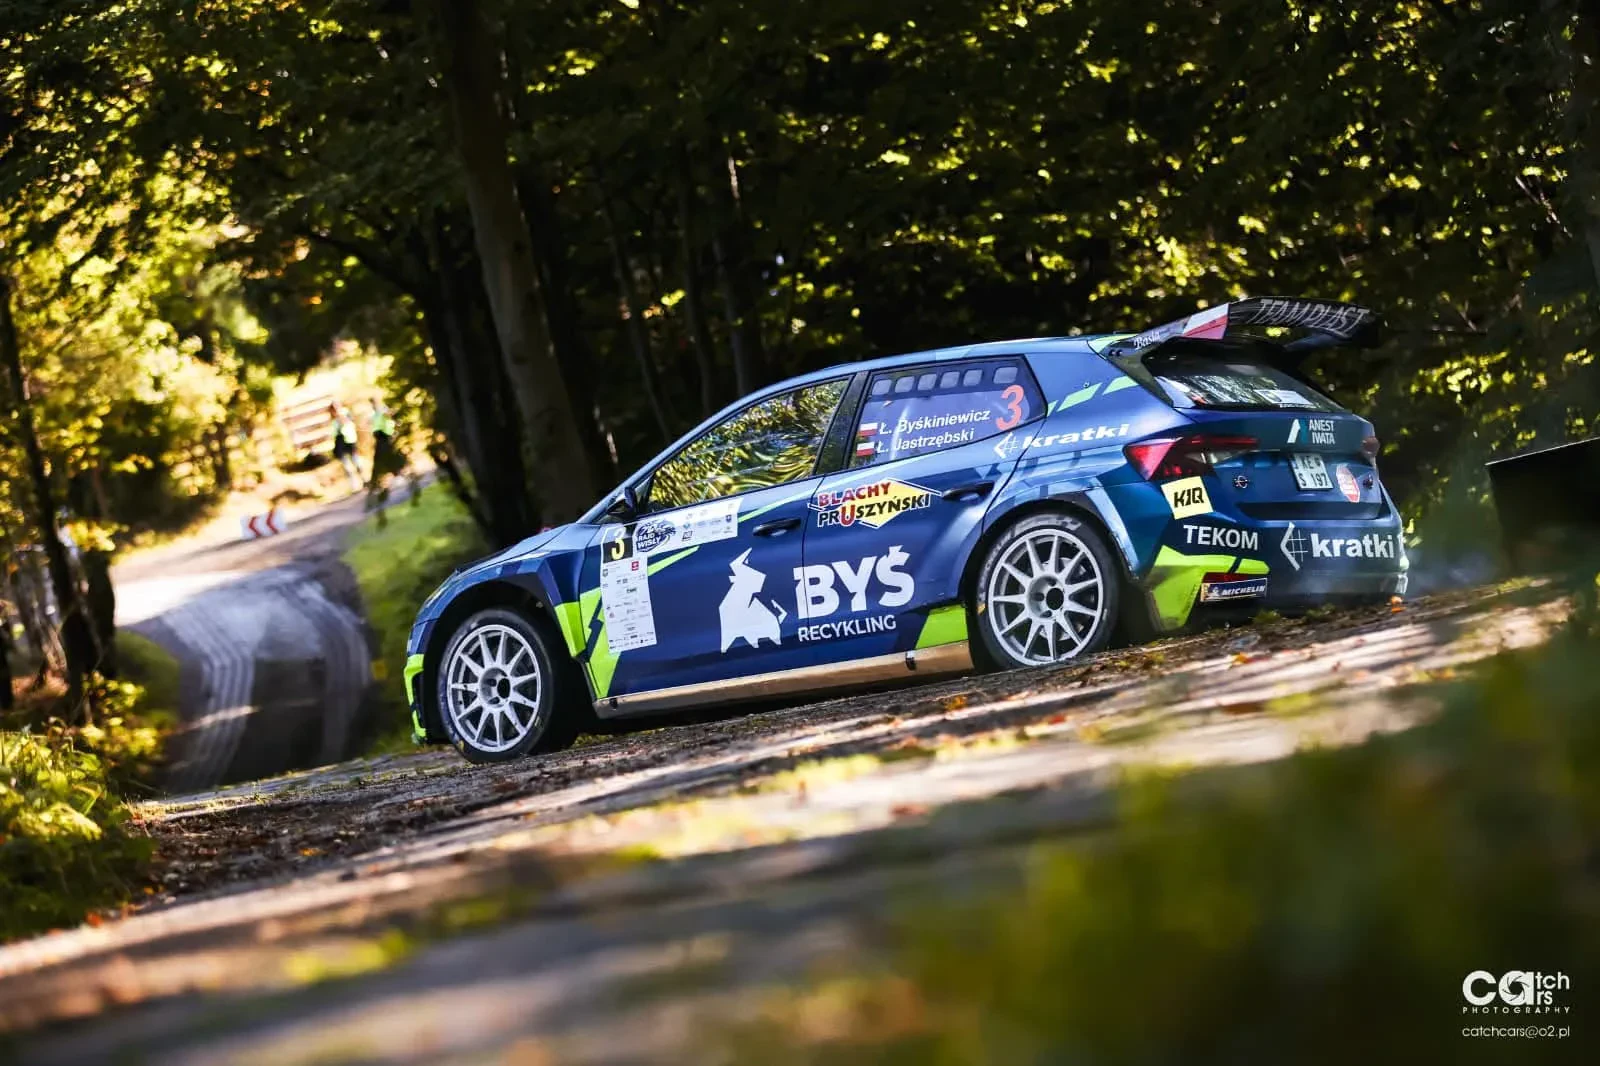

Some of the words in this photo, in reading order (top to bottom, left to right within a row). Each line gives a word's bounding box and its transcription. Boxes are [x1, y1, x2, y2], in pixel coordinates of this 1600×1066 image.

[897, 408, 991, 435] Byśkiniewicz
[996, 384, 1025, 432] 3
[1022, 423, 1130, 450] kratki
[1308, 418, 1335, 432] ANEST
[896, 428, 975, 450] Jastrzębski
[818, 481, 892, 508] BLACHY
[818, 493, 931, 527] PRUSZYŃSKI
[611, 526, 627, 561] 3
[1183, 524, 1259, 551] TEKOM
[1310, 533, 1395, 559] kratki
[793, 545, 915, 620] BYŚ
[798, 614, 897, 642] RECYKLING
